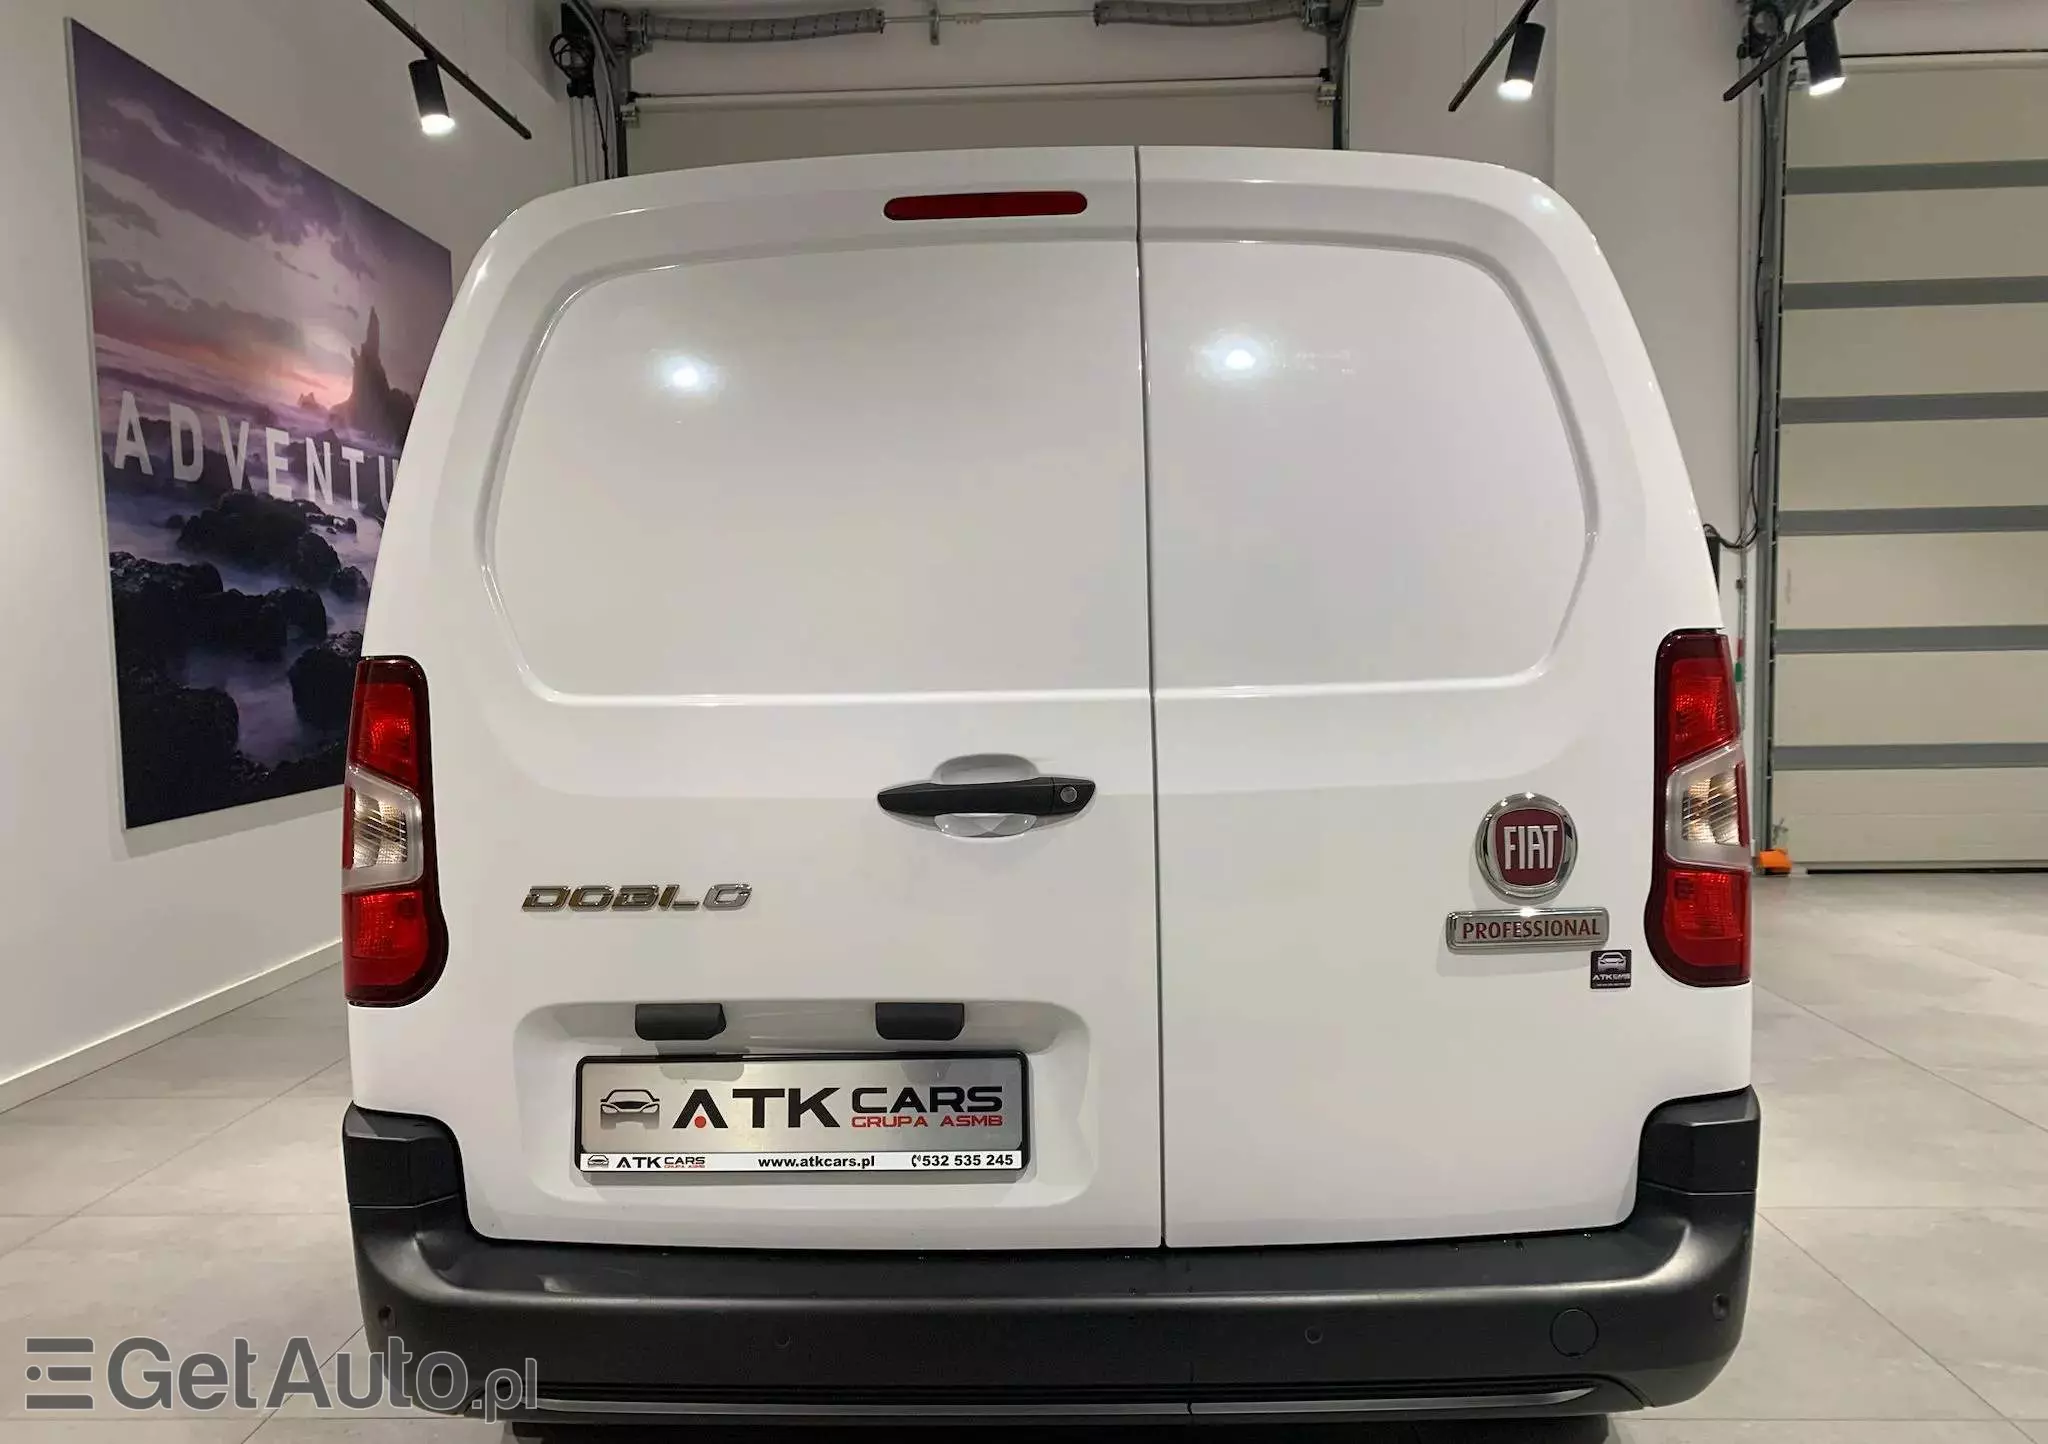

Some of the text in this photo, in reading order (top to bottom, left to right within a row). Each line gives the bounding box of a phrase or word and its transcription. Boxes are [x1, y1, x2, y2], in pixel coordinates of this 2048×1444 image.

[1503, 825, 1558, 869] FIAT
[1462, 918, 1601, 939] PROFESSIONAL
[672, 1087, 1003, 1129] ATK CARS
[851, 1115, 1003, 1128] GRUPA ASMB
[616, 1156, 705, 1169] ATK CARS
[758, 1156, 875, 1170] www.atkcars.pl
[922, 1155, 1013, 1167] 532 535 245
